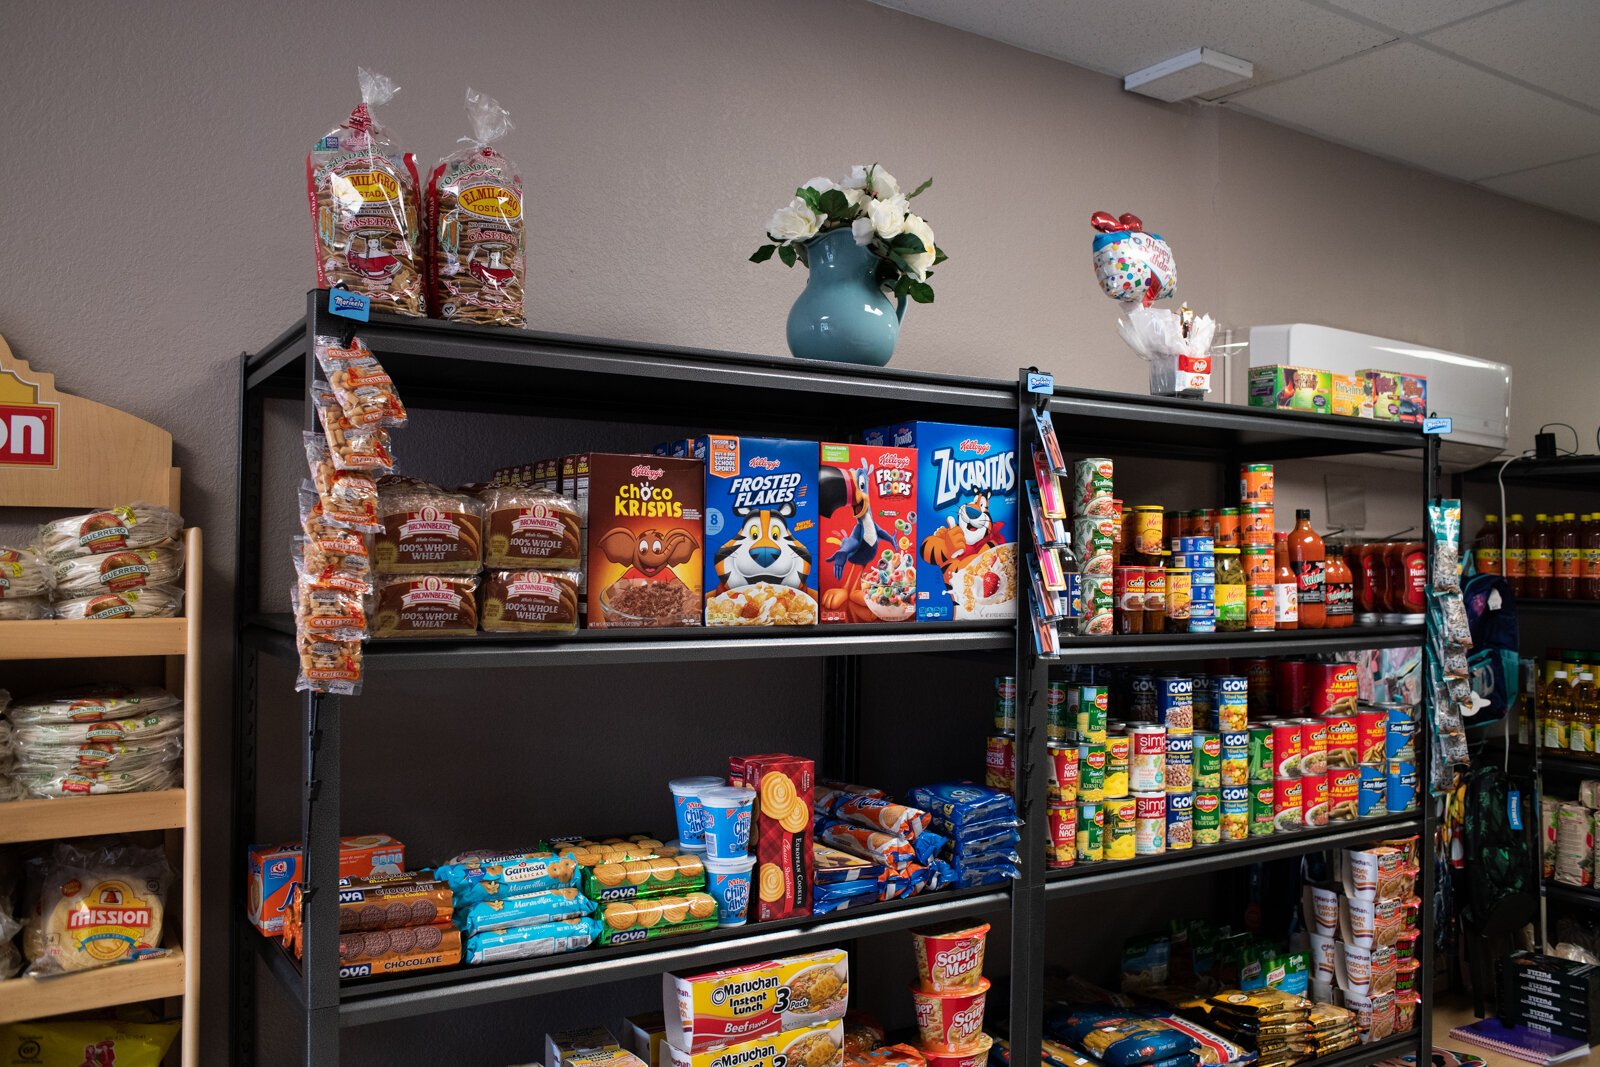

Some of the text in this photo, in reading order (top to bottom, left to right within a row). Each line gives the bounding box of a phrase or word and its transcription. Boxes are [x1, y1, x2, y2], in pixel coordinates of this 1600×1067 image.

[343, 217, 399, 231] CASERAS
[334, 293, 365, 309] Marinela
[960, 439, 991, 455] Kellogg's
[749, 456, 781, 470] Kellogg's
[879, 452, 911, 468] Kellogg's
[875, 468, 912, 483] FROOT
[934, 448, 1015, 505] ZUCARITAS
[730, 473, 802, 494] FROSTED
[880, 482, 912, 497] LOOPS
[734, 487, 796, 508] FLAKES
[615, 495, 683, 517] KRISPIS
[519, 518, 557, 527] BROWNBERRY
[710, 513, 718, 525] 8
[408, 522, 452, 531] BROWNBERRY
[81, 526, 127, 544] GUERRERO
[399, 543, 458, 552] 100% WHOLE
[510, 538, 562, 549] 100% WHOLE
[412, 551, 446, 560] WHEAT
[521, 546, 551, 555] WHEAT
[101, 564, 148, 582] GUERRERO
[514, 583, 554, 592] BROWNBERRY
[411, 592, 453, 601] BROWNBERRY
[505, 602, 558, 613] 100% WHOLE
[401, 612, 458, 620] 100% WHOLE
[516, 611, 546, 620] WHEAT
[412, 619, 445, 628] WHEAT
[1139, 735, 1166, 748] simp
[1137, 798, 1166, 814] simp
[504, 863, 546, 876] Gamesa
[375, 885, 435, 896] CHOCOLATE
[508, 881, 546, 892] Maravillas
[601, 889, 637, 900] GOYA
[724, 885, 747, 902] Chips
[513, 897, 552, 909] Maravillas
[612, 930, 647, 943] GOYA
[936, 939, 984, 967] Souper
[339, 956, 443, 978] OYA CHOCOLATE
[945, 954, 979, 978] Meal
[1527, 968, 1552, 980] PUZZLE
[724, 976, 778, 998] Maruchan
[1528, 981, 1553, 992] PUZZLE
[729, 991, 767, 1008] Instant
[773, 986, 808, 1013] 3 Pack
[1527, 995, 1552, 1006] PUZZLE
[733, 1003, 763, 1016] Lunch
[1529, 1008, 1554, 1019] PUZZLE
[724, 1018, 769, 1033] Beef Flavor
[1527, 1021, 1551, 1033] PUZZLE
[1172, 1017, 1235, 1058] LARGE ELBOWS
[721, 1045, 775, 1067] Maruchan
